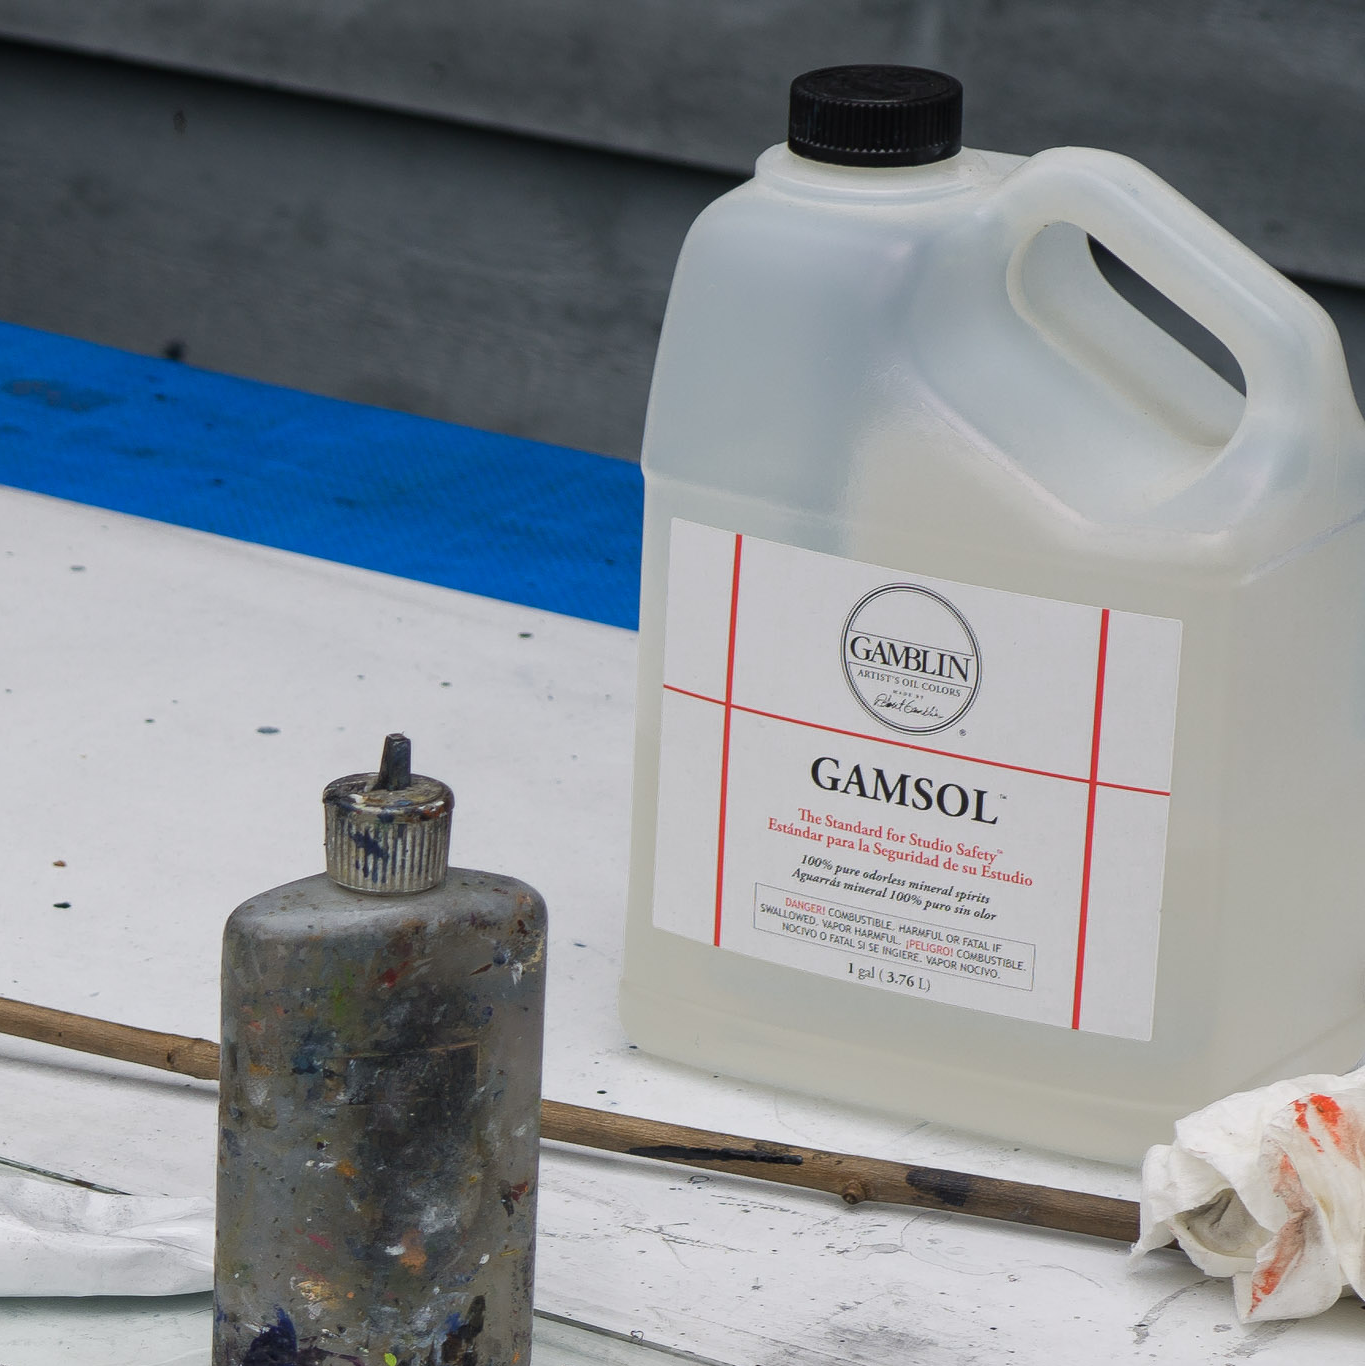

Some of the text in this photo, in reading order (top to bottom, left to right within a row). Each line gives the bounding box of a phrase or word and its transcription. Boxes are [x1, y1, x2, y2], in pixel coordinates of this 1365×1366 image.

[850, 636, 971, 682] GAMBLIN
[857, 670, 960, 697] ARTIST'S OIL COLORS
[768, 817, 1033, 886] Estándar para la Seguridad de su Estudio
[798, 808, 822, 825] The
[825, 815, 883, 838] Standard
[886, 828, 906, 843] for
[909, 833, 952, 853] Studio
[792, 868, 840, 890] Aguarrás
[843, 881, 887, 897] mineral
[890, 890, 922, 906] 100%
[924, 900, 951, 916] puro
[974, 908, 996, 921] olor
[801, 854, 990, 905] 100% pure odorless mineral spirits
[785, 898, 1002, 952] DANGER! HARMFUL OR FATAL IF
[822, 919, 851, 933] VAPOR
[906, 939, 954, 957] ¡PELIGRO!
[782, 922, 817, 938] NOCIVO
[820, 931, 827, 941] O
[829, 934, 855, 948] FATAL
[858, 940, 865, 949] SI
[869, 943, 879, 953] SE
[926, 956, 958, 970] VAPOR
[960, 963, 1001, 980] NOCIVO.
[849, 963, 853, 974] 1
[858, 966, 875, 980] gal
